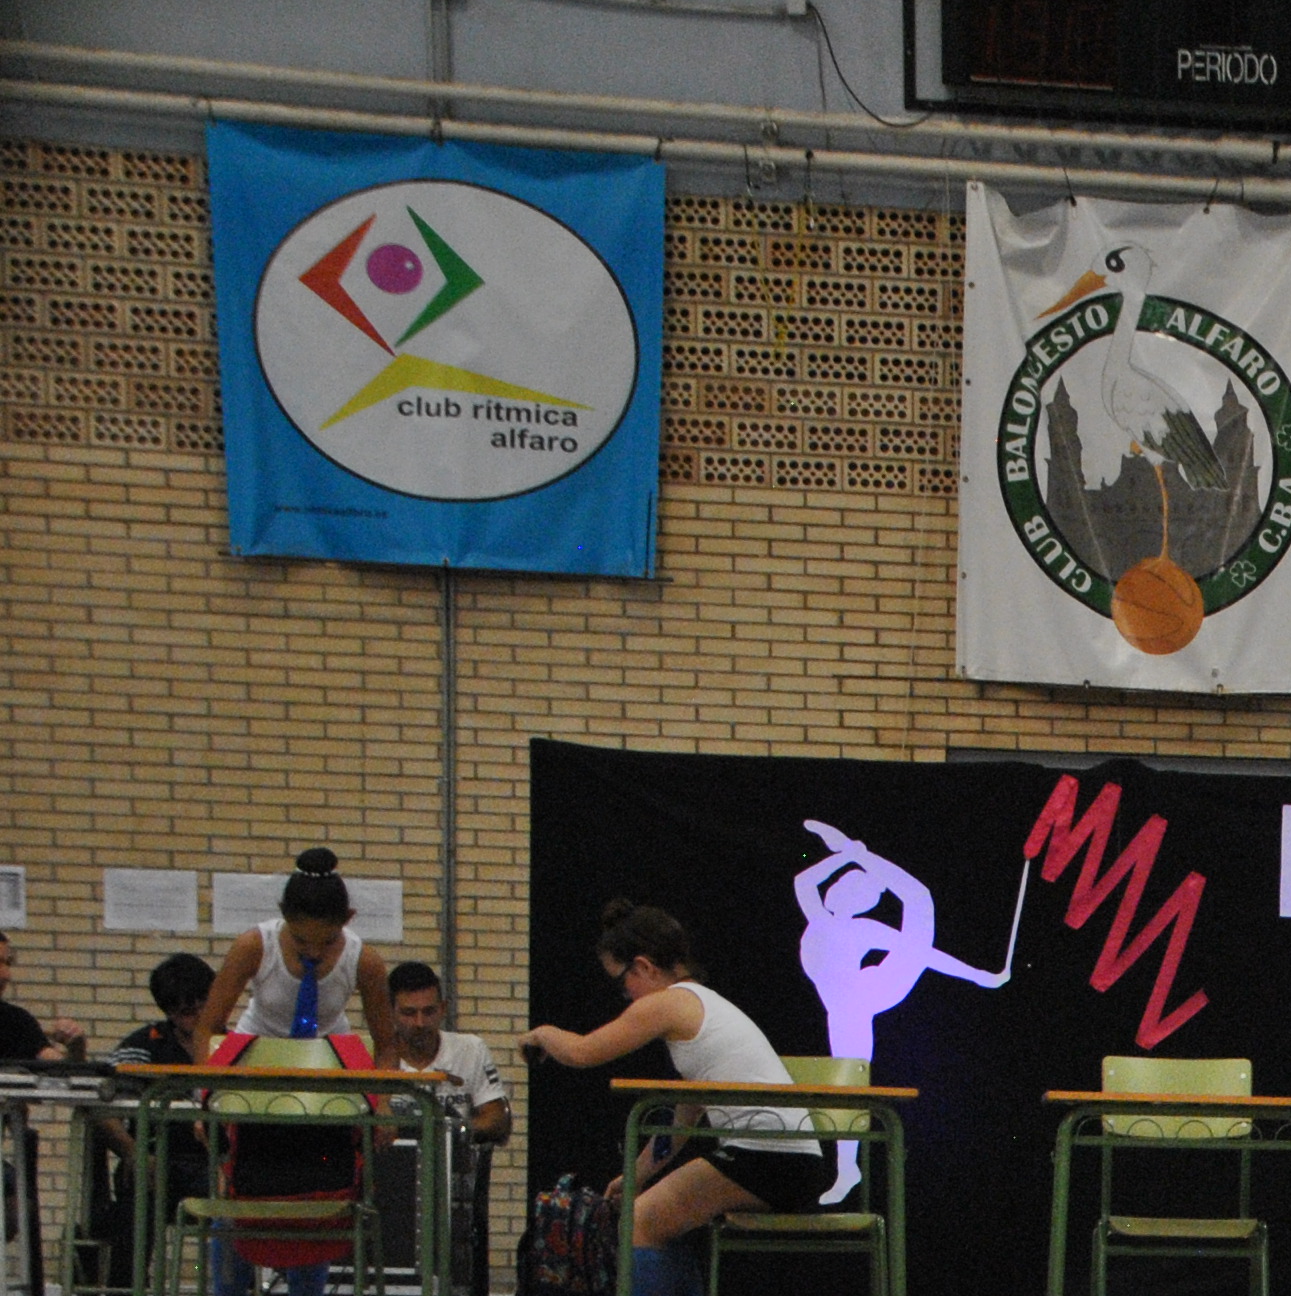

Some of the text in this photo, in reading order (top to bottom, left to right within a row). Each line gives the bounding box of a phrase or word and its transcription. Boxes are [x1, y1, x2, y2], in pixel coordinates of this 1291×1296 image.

[1177, 48, 1278, 85] PERIODO
[397, 396, 462, 418] club
[490, 428, 579, 453] alfaro
[1023, 514, 1092, 593] CLUB
[1166, 307, 1280, 396] ALFARO
